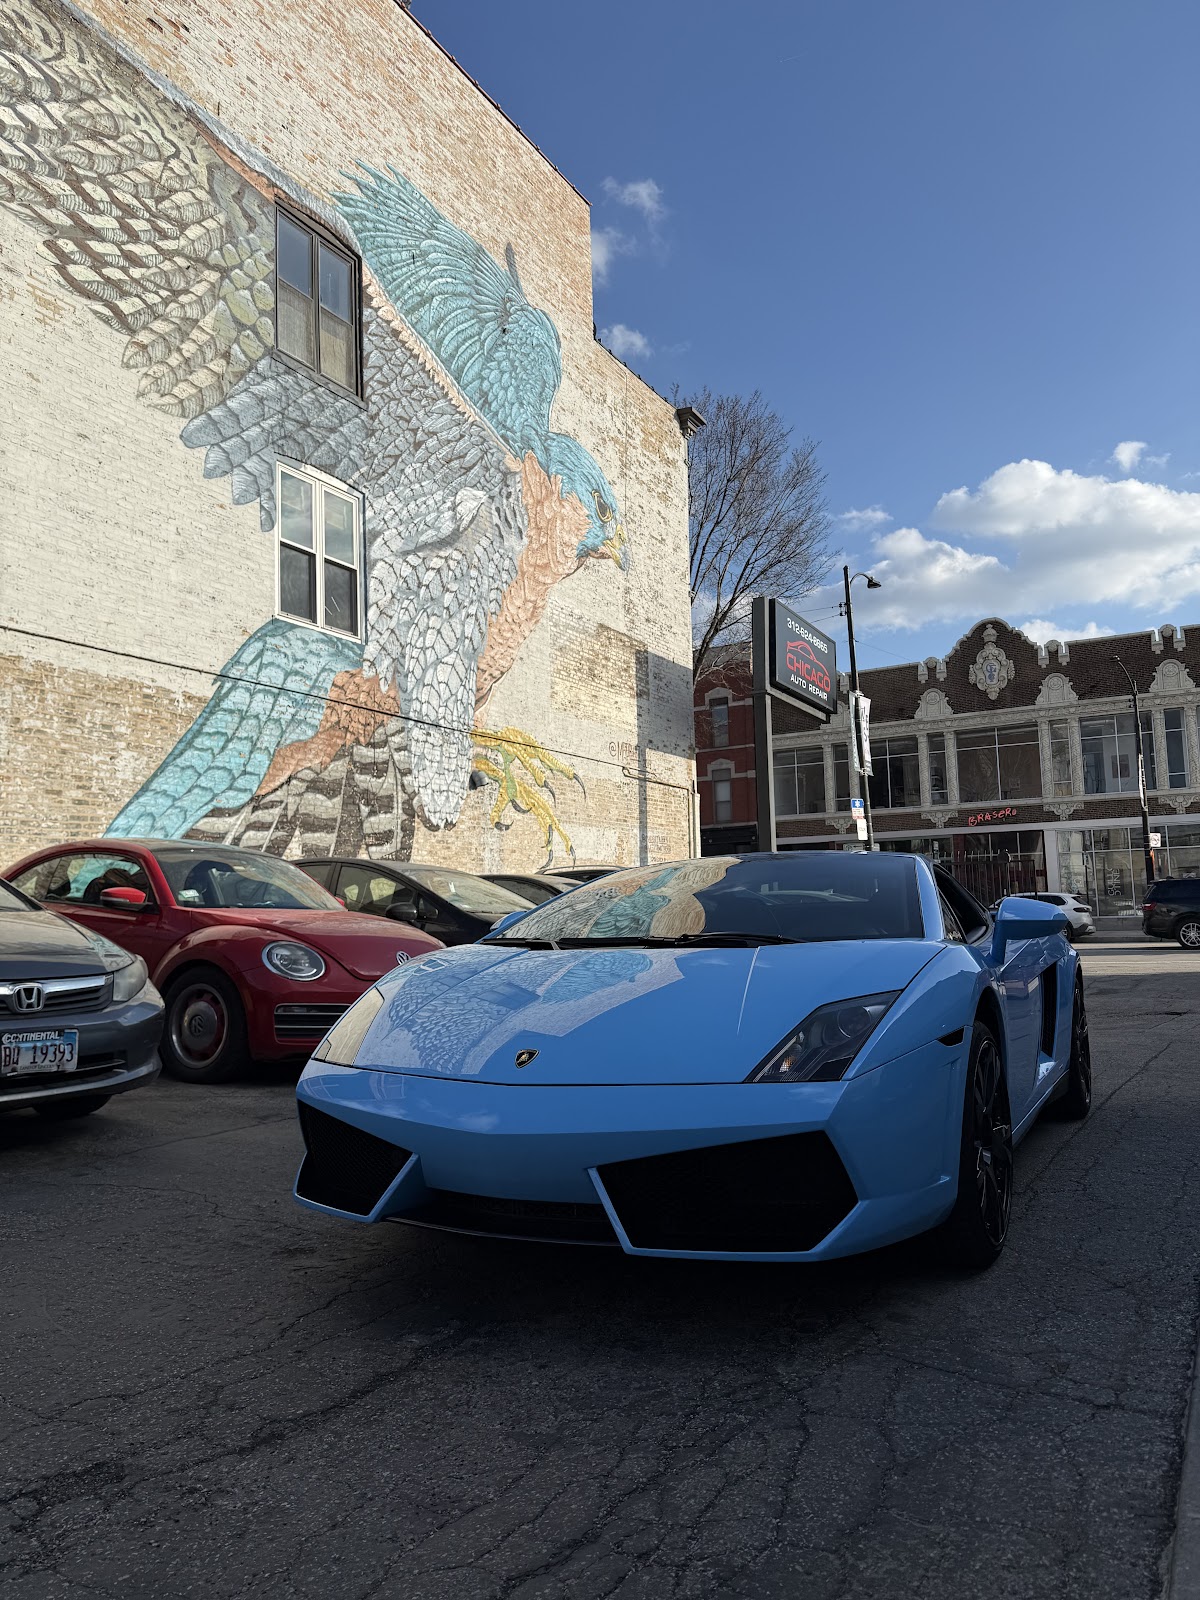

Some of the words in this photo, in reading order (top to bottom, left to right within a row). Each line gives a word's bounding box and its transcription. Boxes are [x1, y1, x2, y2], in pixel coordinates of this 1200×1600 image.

[786, 653, 830, 691] CHICAGO
[791, 673, 807, 689] AUTO
[808, 683, 828, 701] REPAIR
[30, 1043, 74, 1064] 19393
